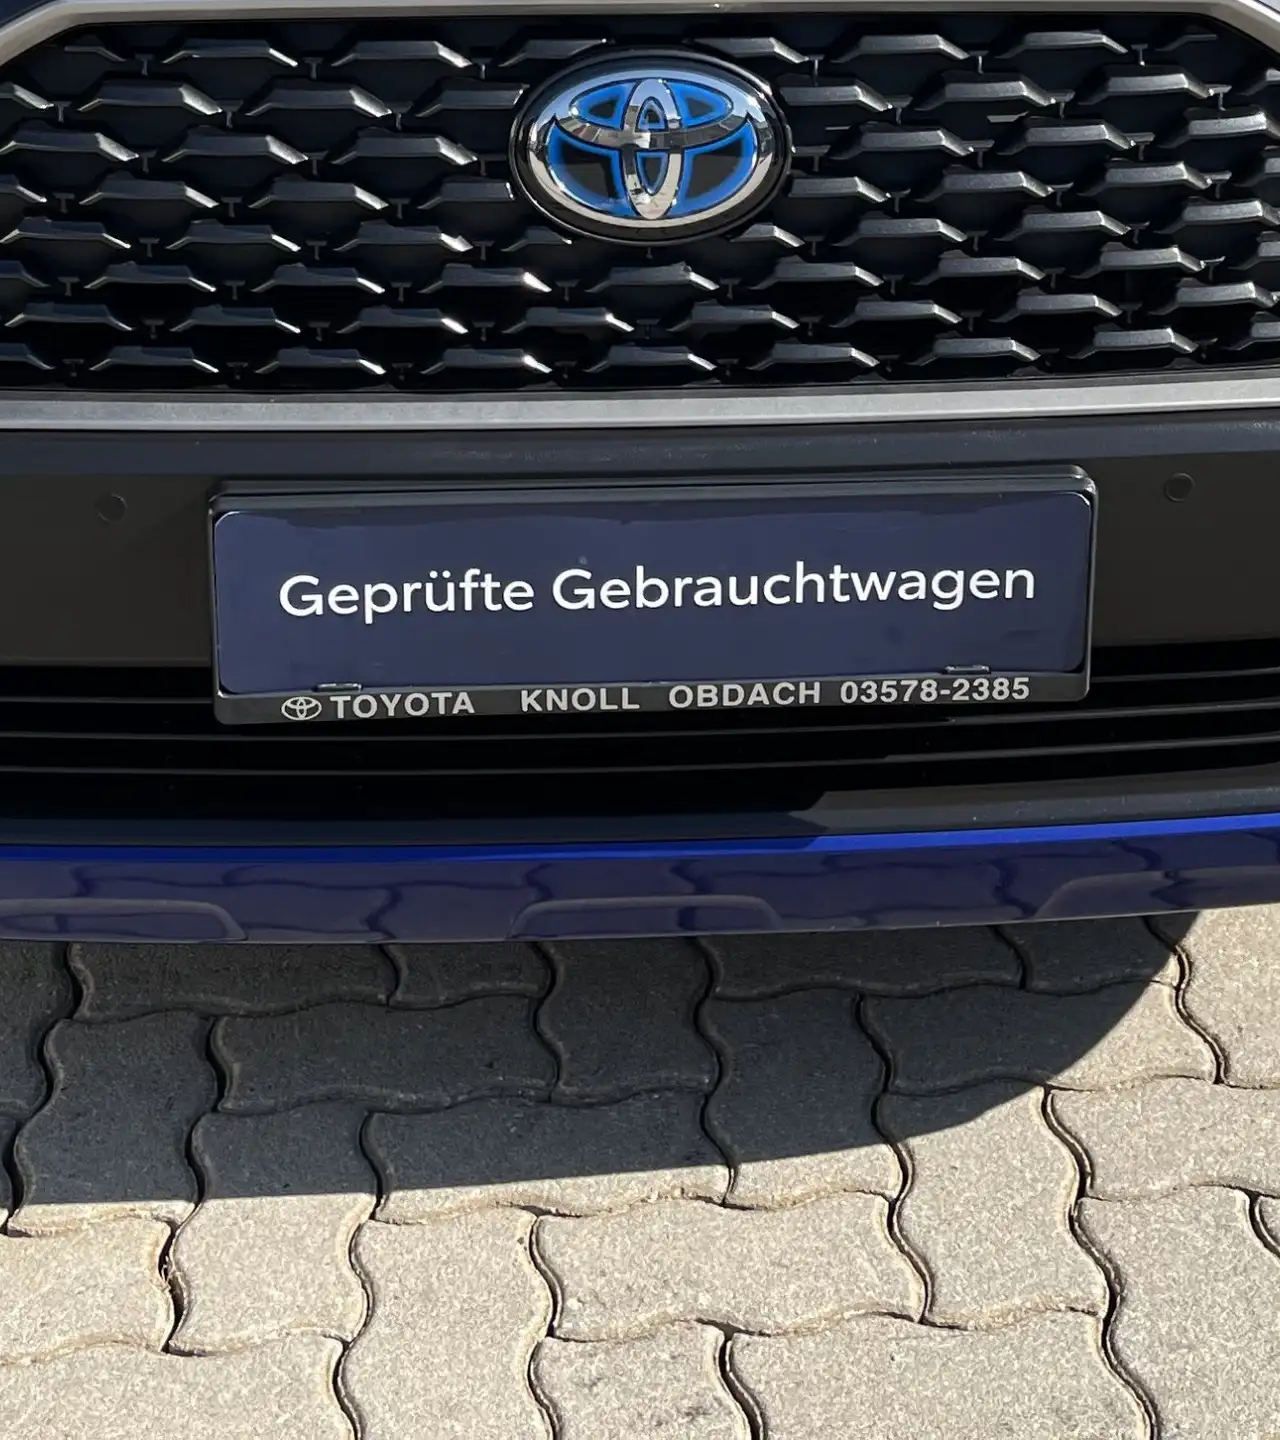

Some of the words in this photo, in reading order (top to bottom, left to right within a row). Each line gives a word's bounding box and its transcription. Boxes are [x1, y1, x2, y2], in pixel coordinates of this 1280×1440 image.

[279, 568, 535, 624] Geprüfte
[552, 561, 1035, 611] Gebrauchtwagen
[329, 691, 475, 719] TOYOTA
[521, 687, 641, 712] KNOLL
[668, 681, 821, 708] OBDACH
[840, 677, 1030, 704] 03578-2385
